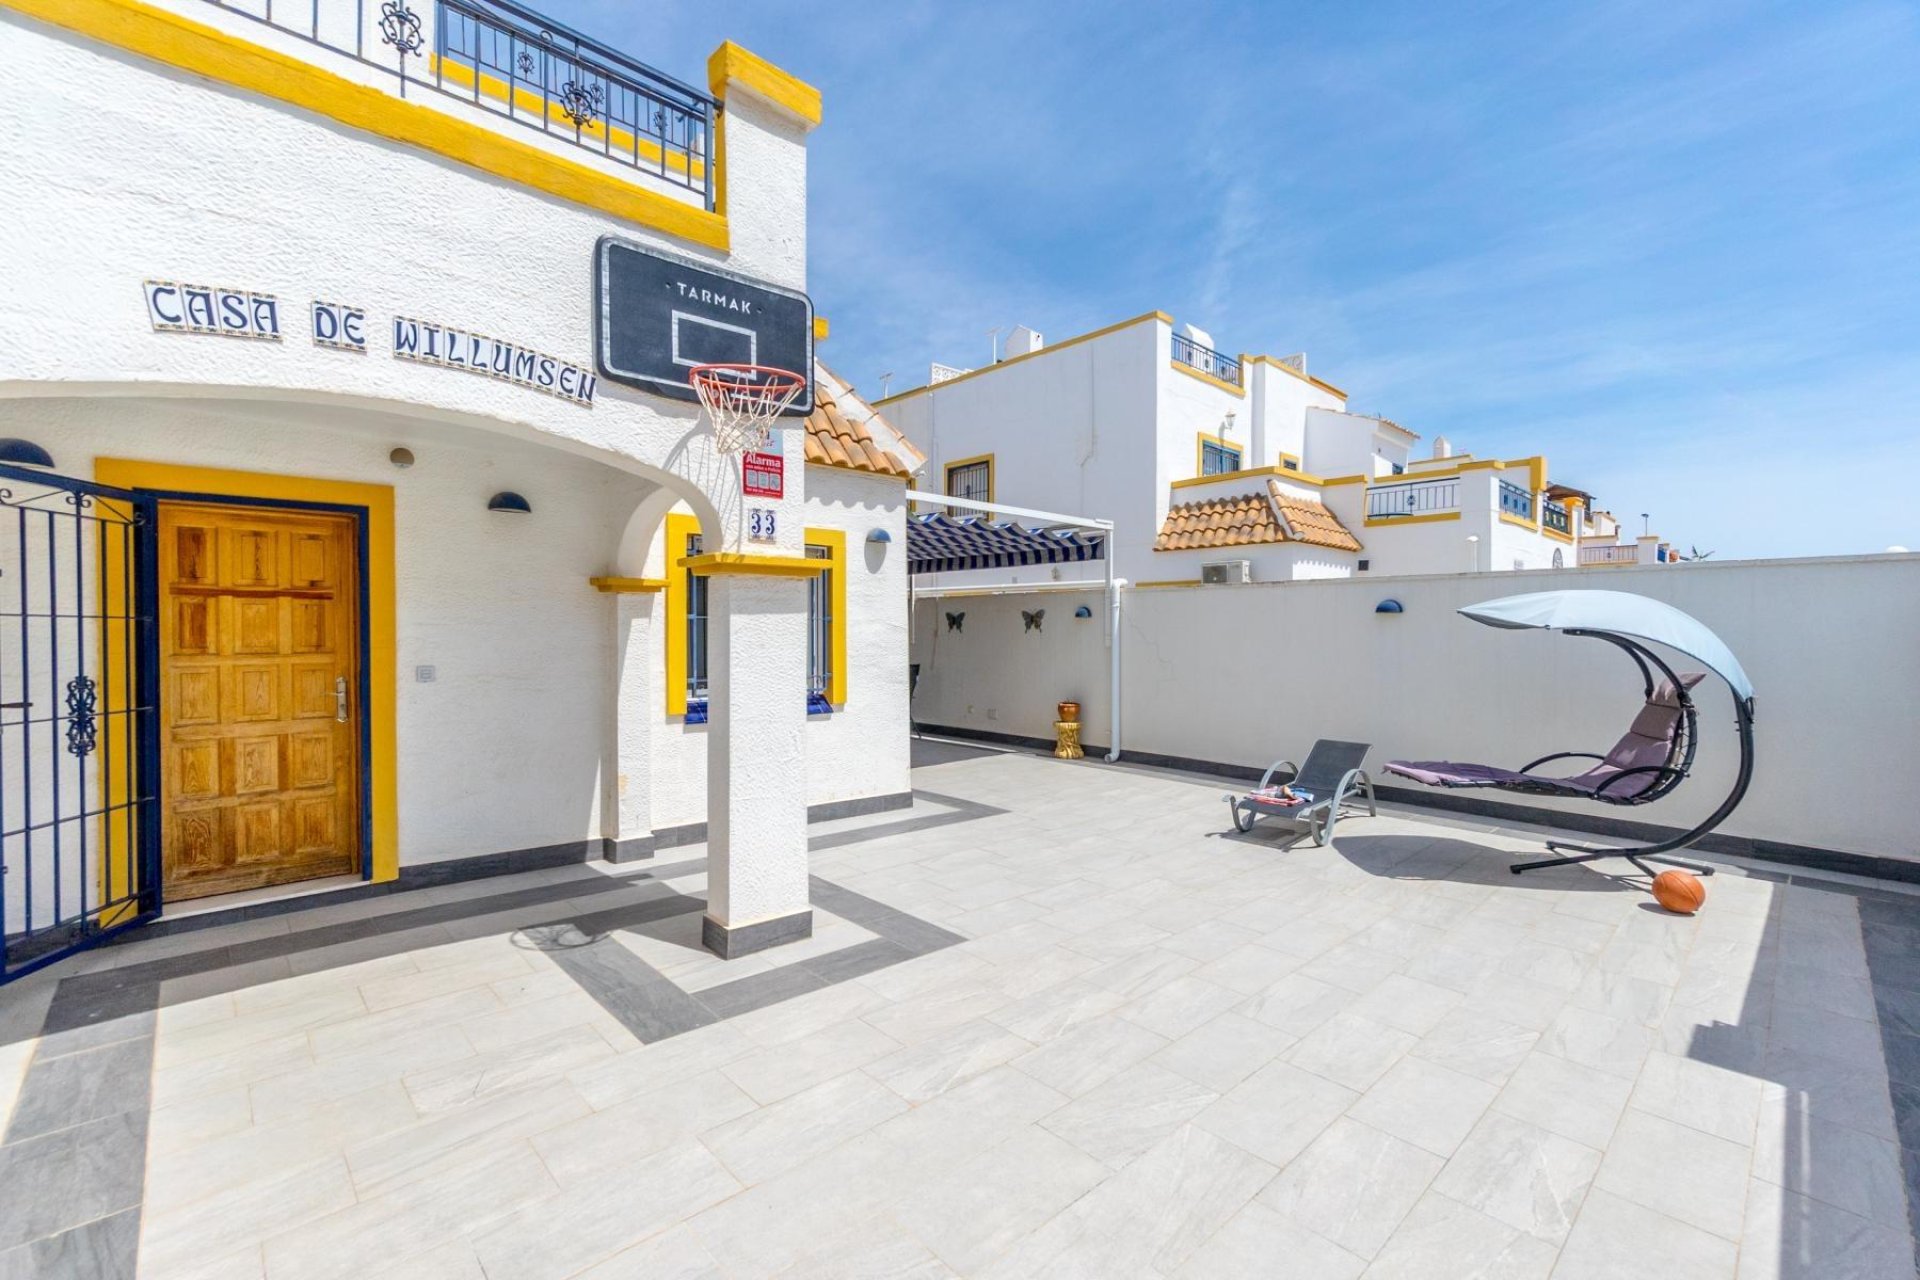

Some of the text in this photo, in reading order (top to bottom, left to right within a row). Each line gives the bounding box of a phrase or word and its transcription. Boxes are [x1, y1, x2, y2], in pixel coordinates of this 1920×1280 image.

[676, 282, 751, 315] TARMAK
[152, 286, 597, 402] CASA DE WILLUMSEN
[746, 453, 781, 468] Alarma
[751, 513, 775, 535] 33
